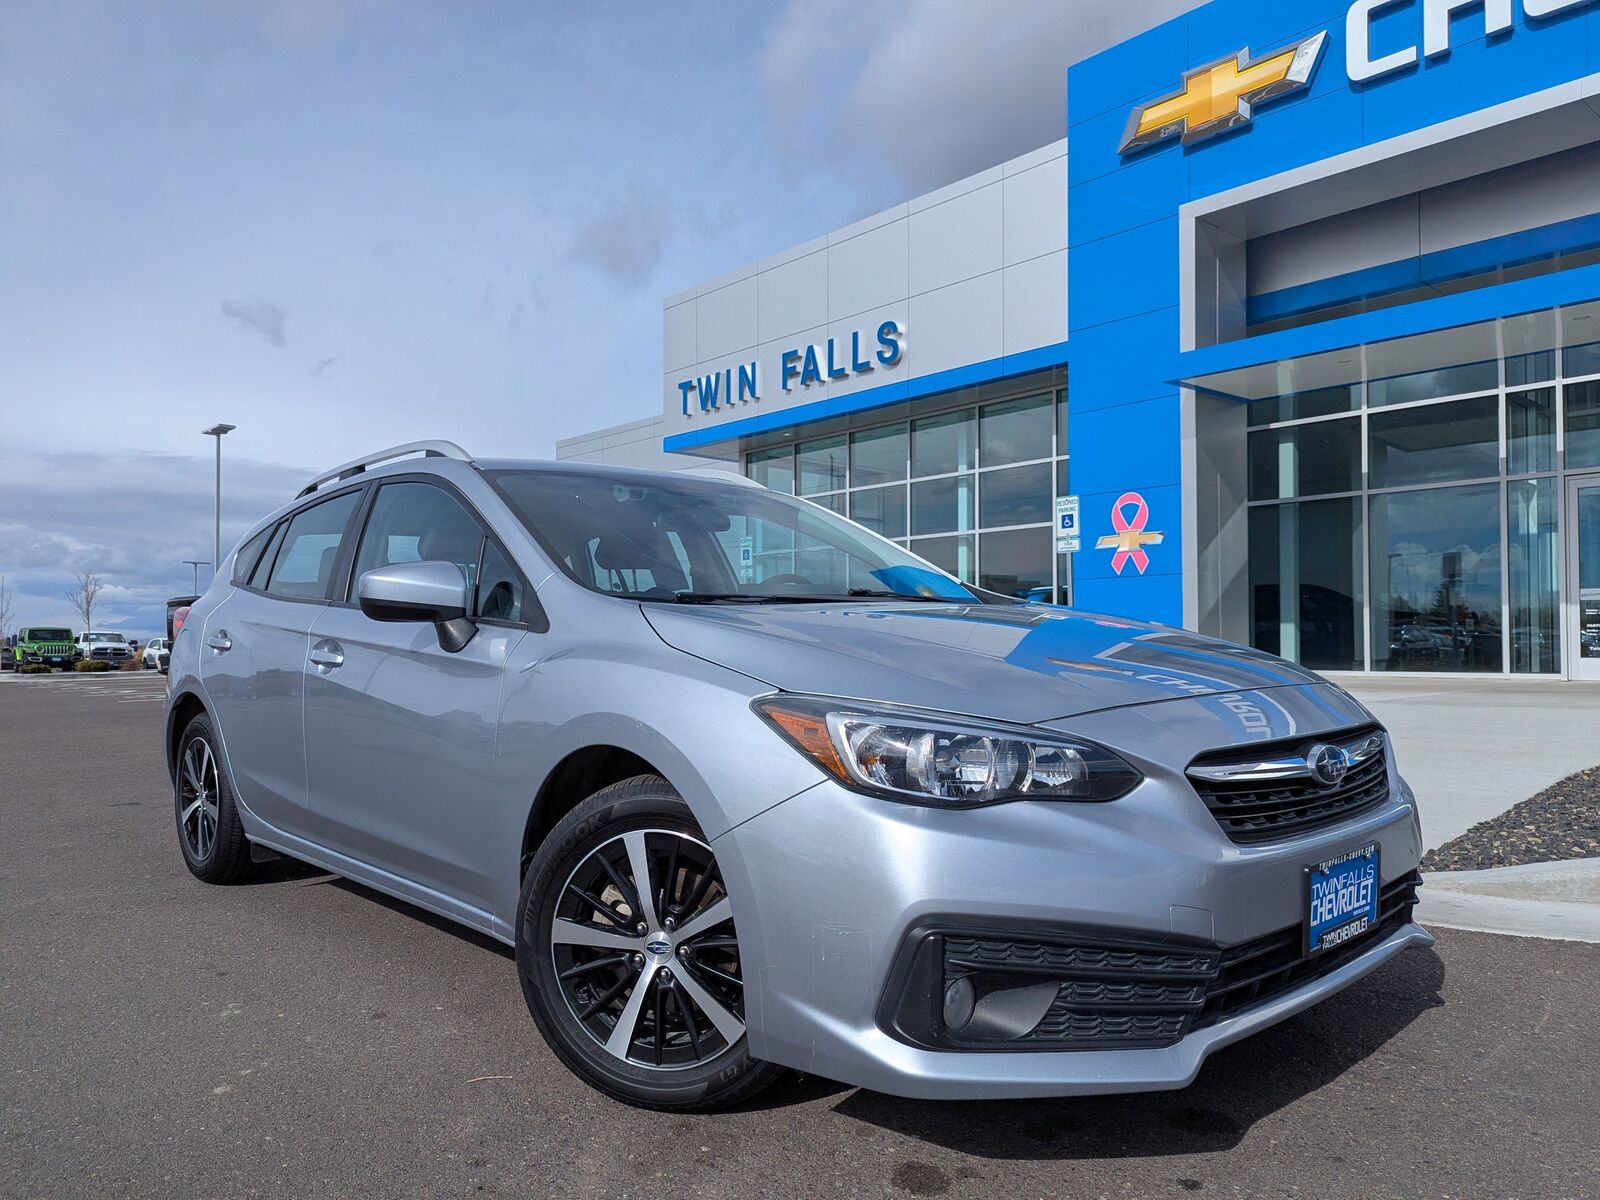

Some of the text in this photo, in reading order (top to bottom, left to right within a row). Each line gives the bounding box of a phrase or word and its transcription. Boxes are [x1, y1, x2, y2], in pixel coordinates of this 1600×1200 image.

[1346, 0, 1600, 81] CH
[678, 320, 902, 416] TWIN FALLS
[1310, 879, 1374, 927] CHEVROLET
[1336, 916, 1368, 943] CHEVROLET
